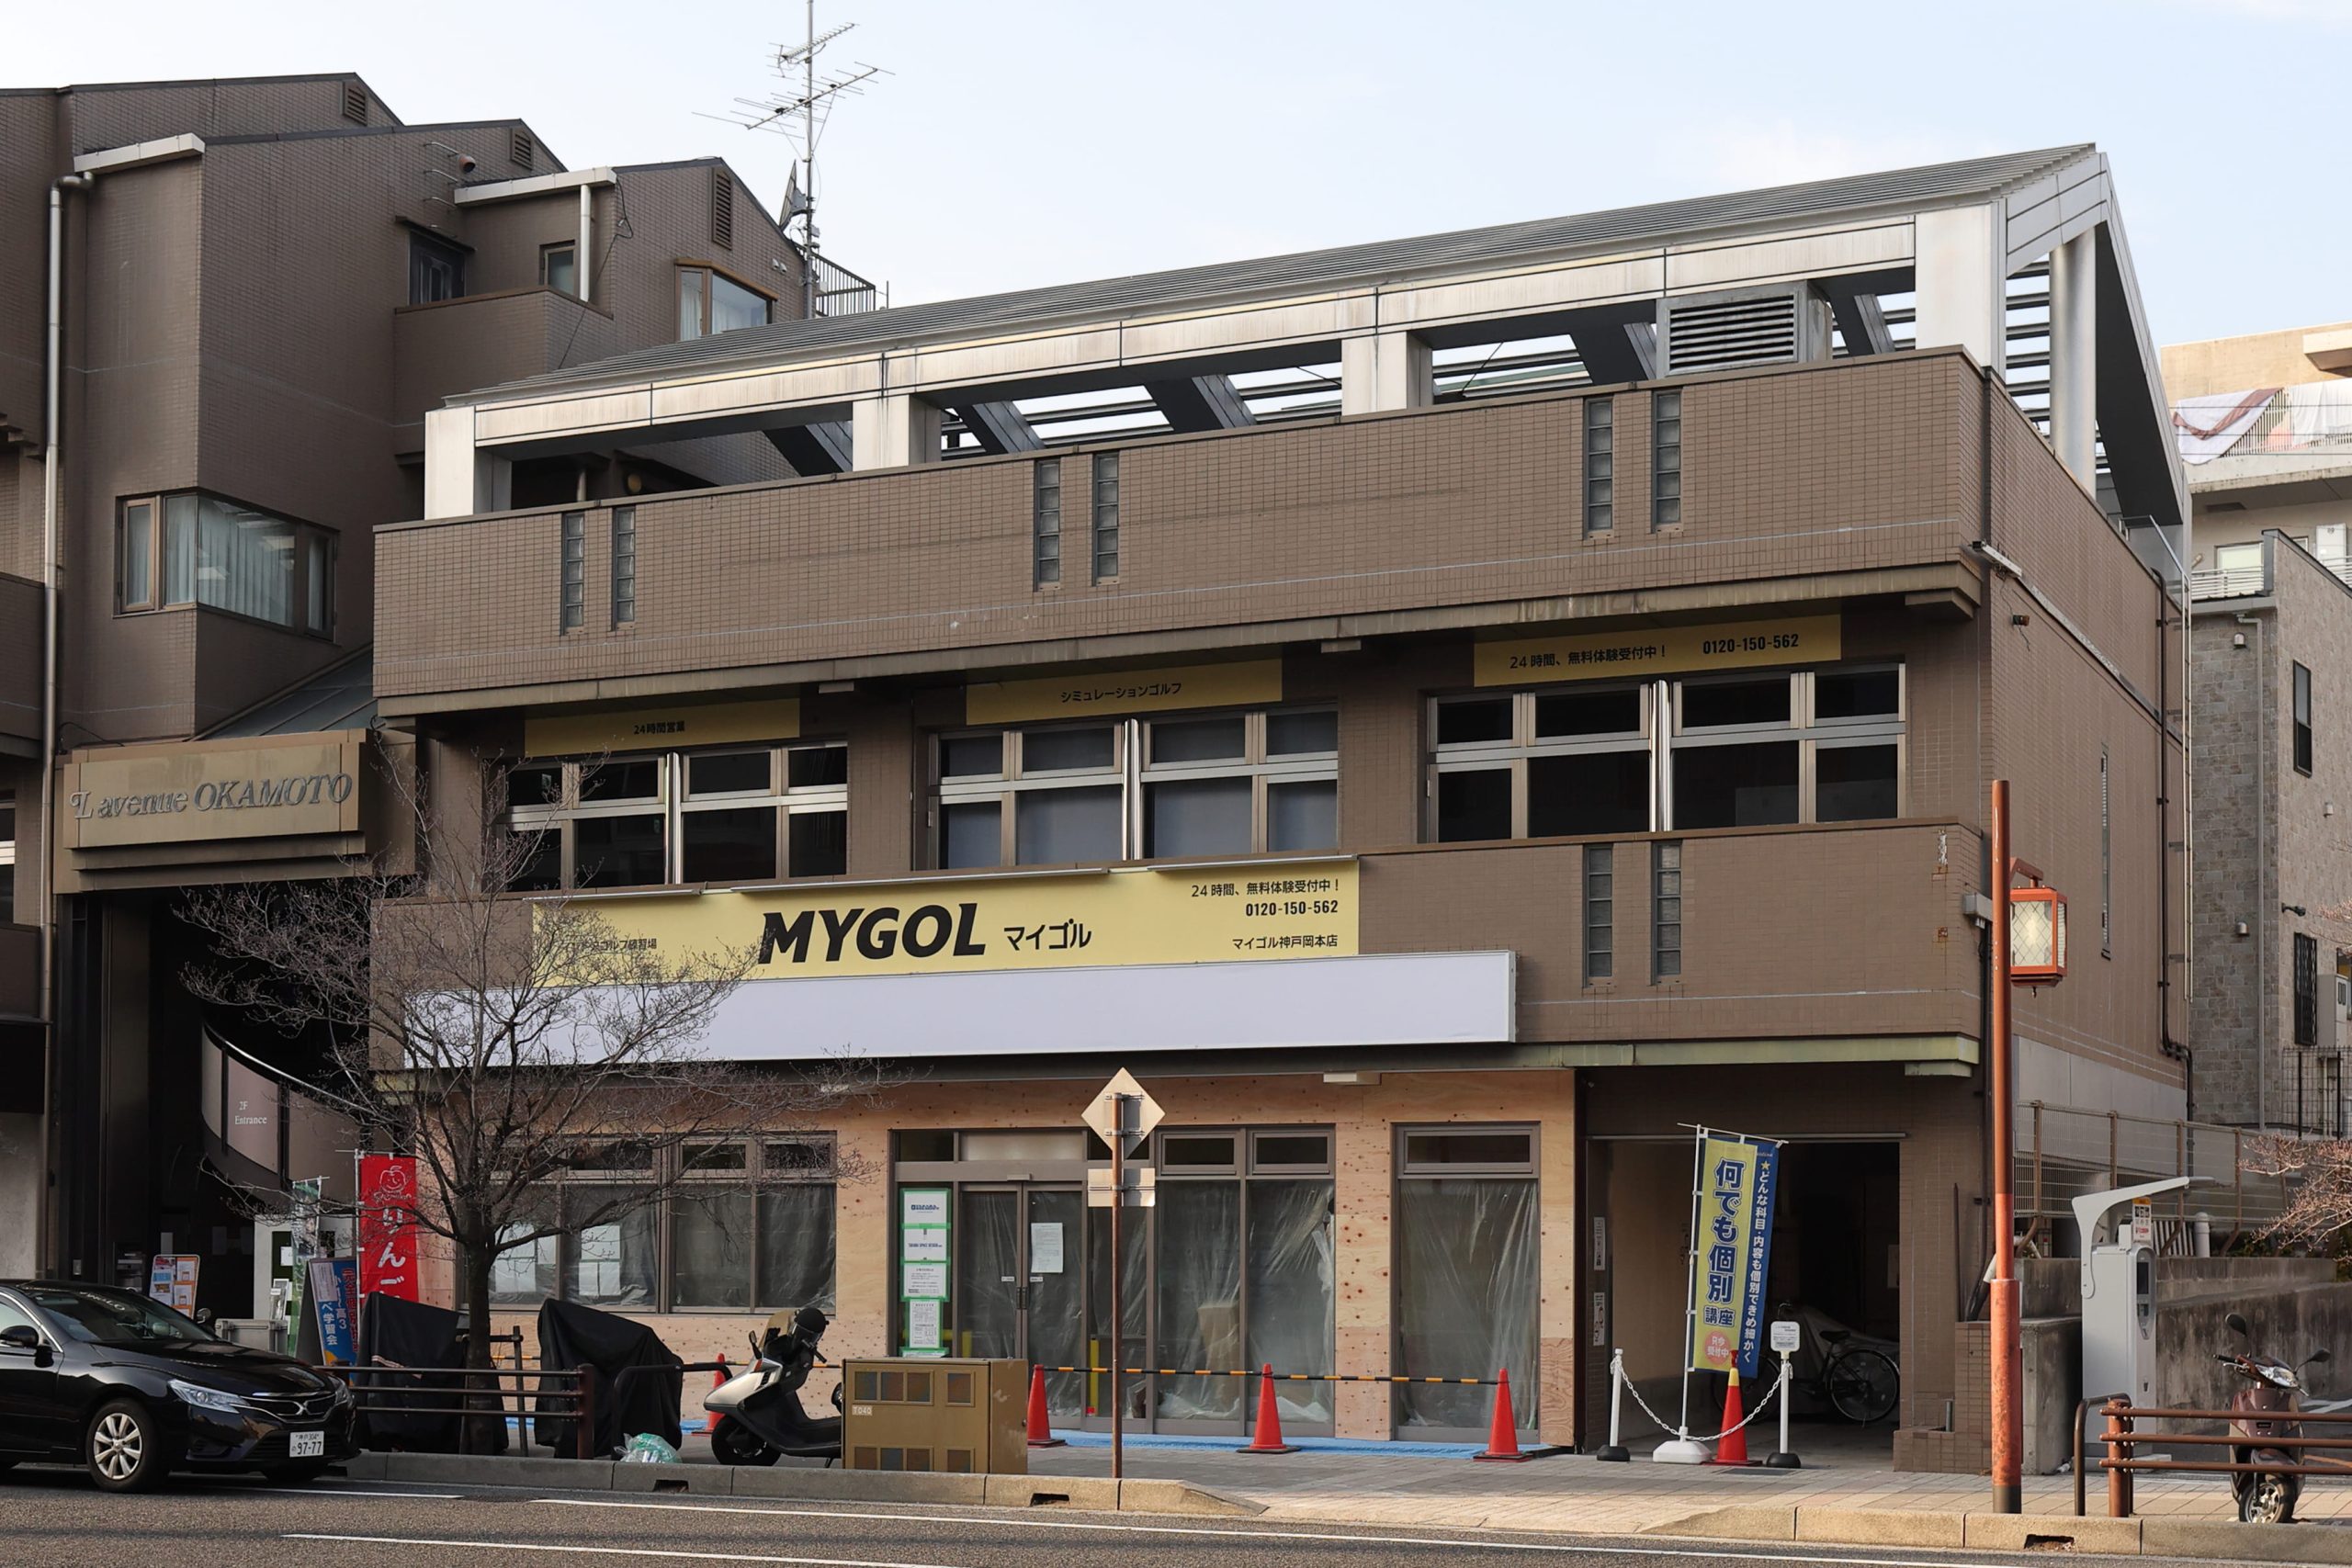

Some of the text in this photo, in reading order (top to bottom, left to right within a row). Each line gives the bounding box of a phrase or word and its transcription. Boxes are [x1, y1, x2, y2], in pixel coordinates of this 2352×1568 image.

[1702, 633, 1800, 656] 0120-150-562
[1060, 682, 1182, 703] シミュレーションゴルフ
[194, 773, 353, 812] OKAMOTO
[1246, 899, 1339, 917] 0120-150-562
[758, 902, 1092, 964] MYGOL マイゴル
[1232, 934, 1338, 950] マイゴル神戸岡本店
[234, 1115, 267, 1125] Entrance
[1706, 1156, 1747, 1304] 何でも個別
[1703, 1305, 1736, 1327] 講座
[297, 1441, 322, 1455] 97-77
